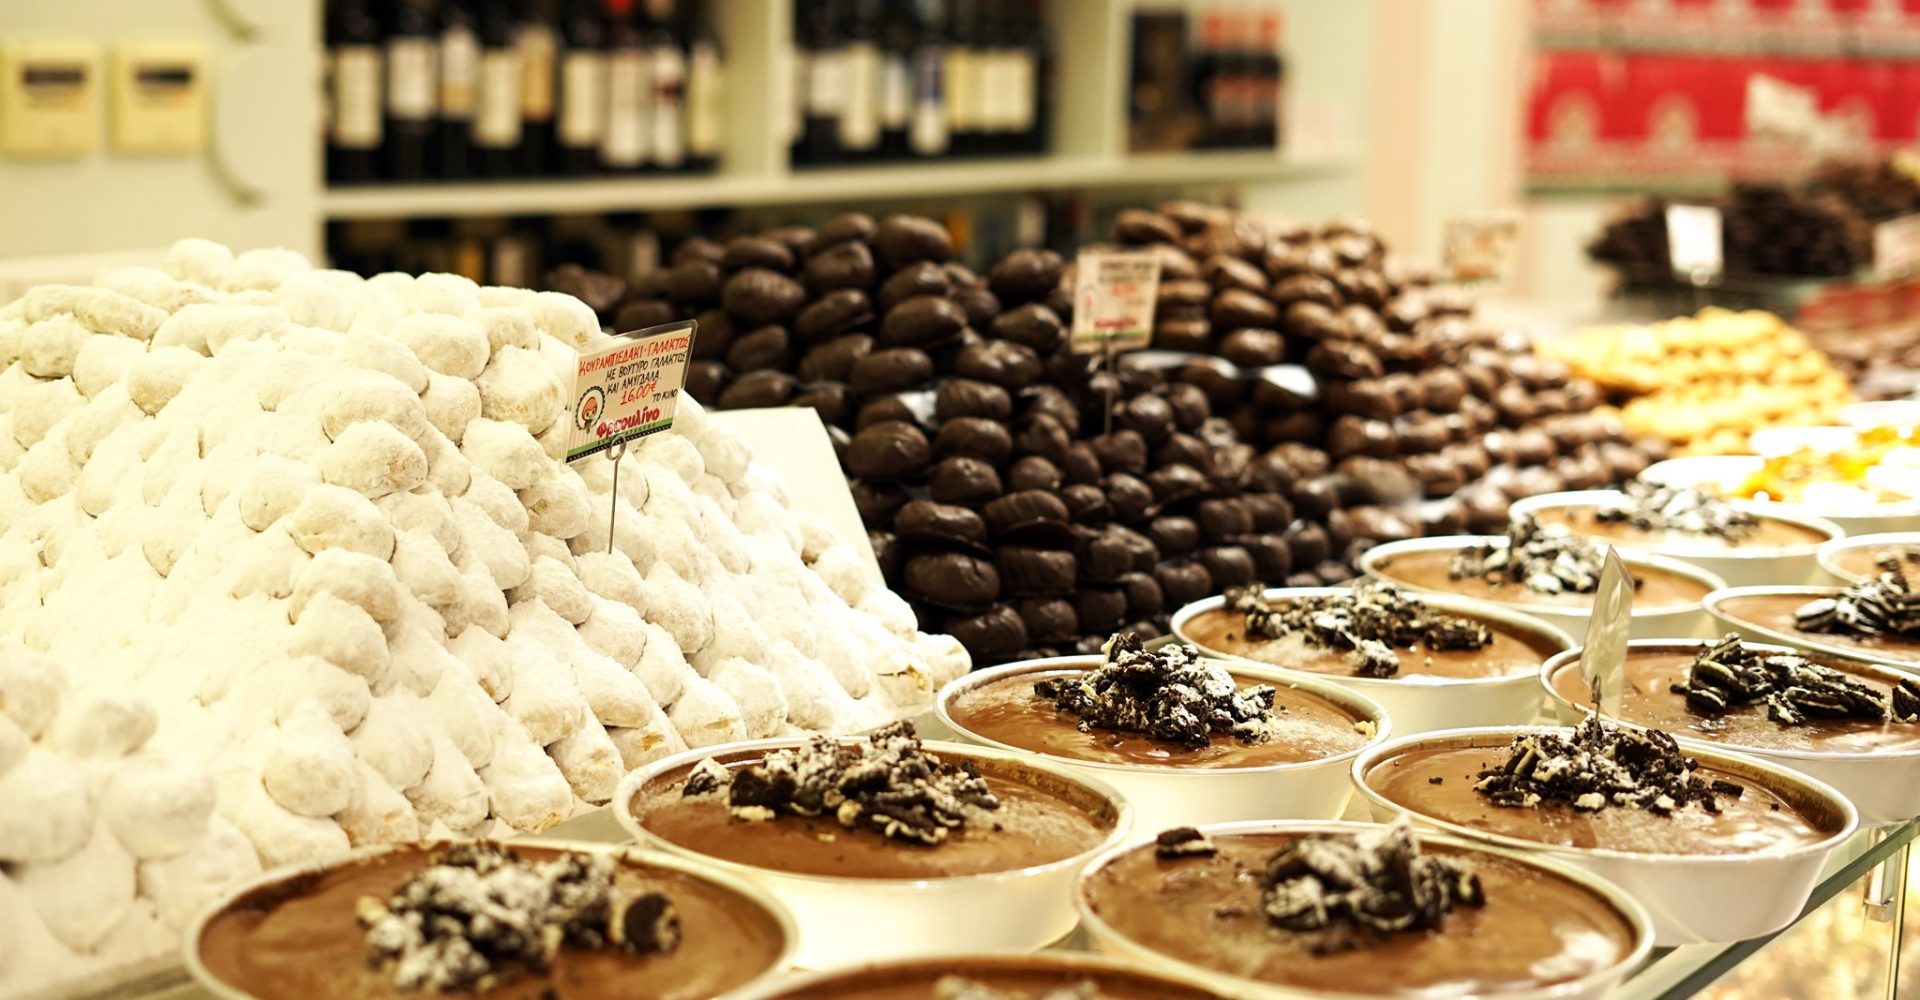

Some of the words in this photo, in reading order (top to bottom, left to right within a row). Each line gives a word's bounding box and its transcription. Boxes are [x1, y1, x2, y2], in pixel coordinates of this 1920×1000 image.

[618, 361, 649, 378] ΒΟΥΤΥΡΟ
[606, 382, 620, 395] ΚΑΙ
[620, 380, 657, 405] 16,00€
